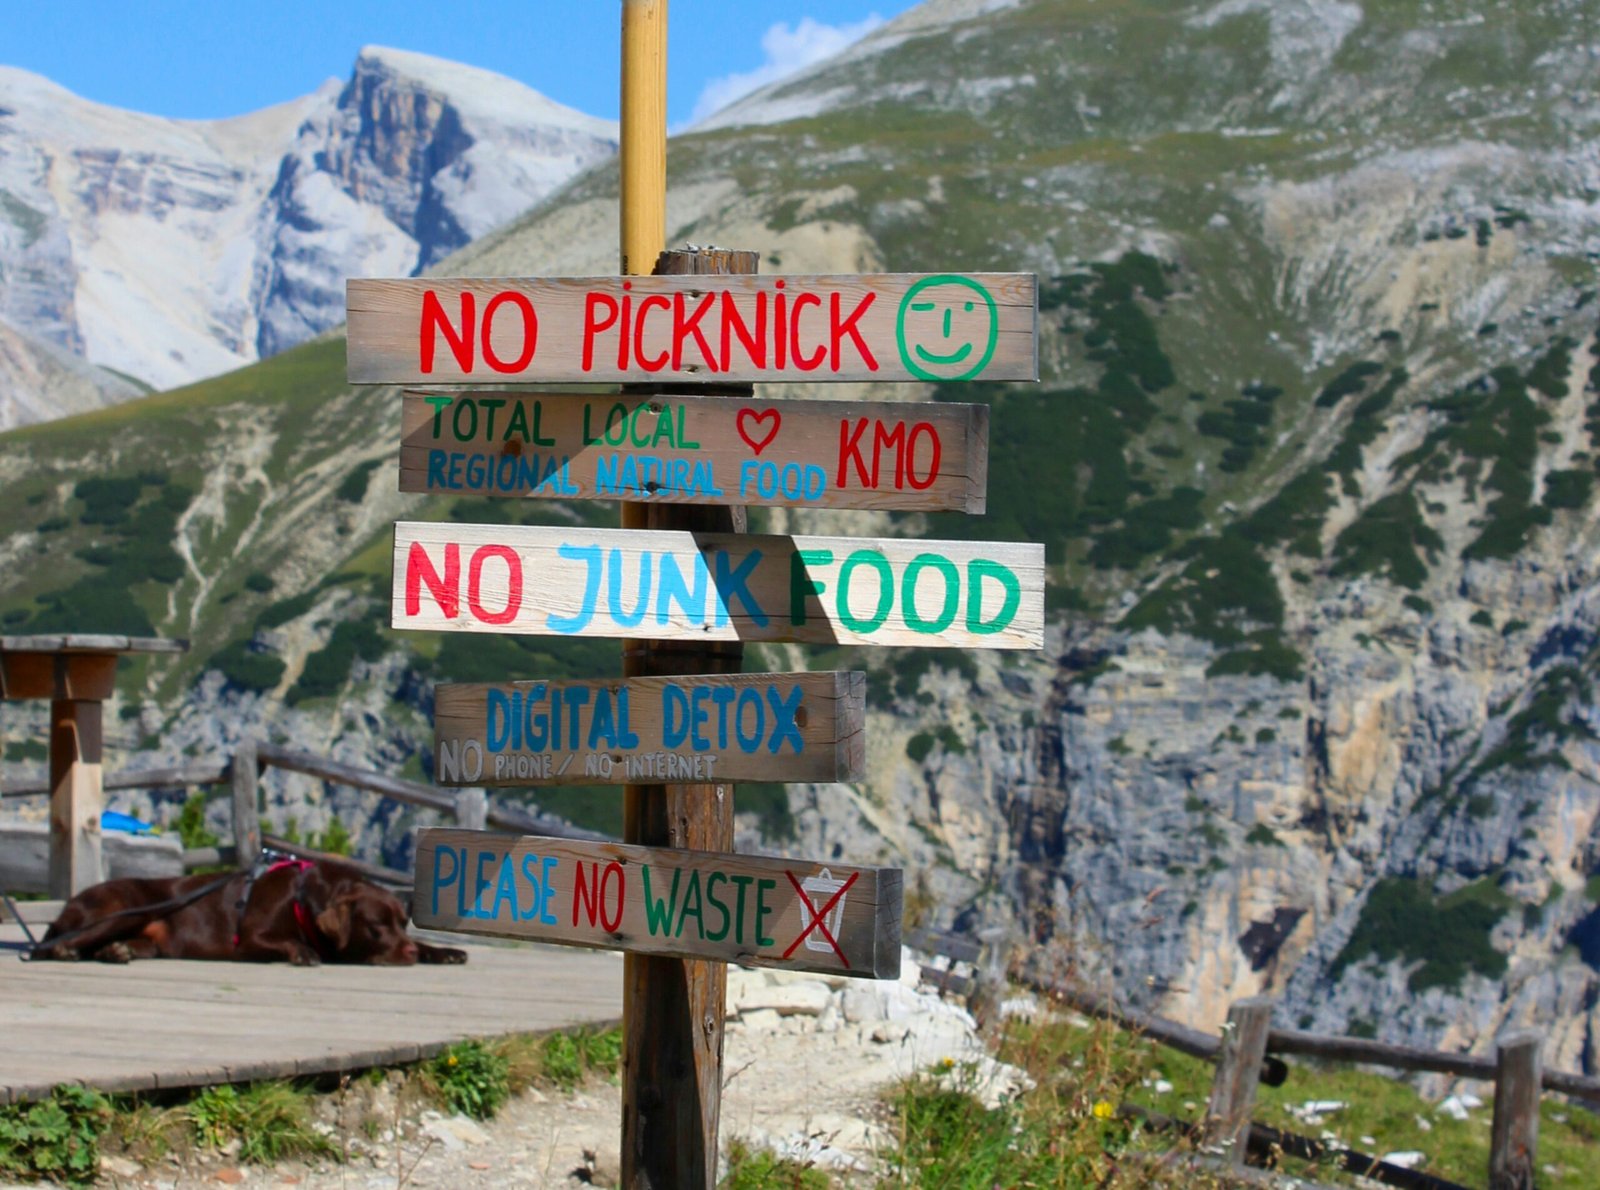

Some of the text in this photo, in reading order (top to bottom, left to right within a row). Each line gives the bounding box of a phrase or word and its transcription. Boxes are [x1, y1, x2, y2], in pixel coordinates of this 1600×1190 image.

[420, 289, 537, 373] NO
[425, 396, 555, 446] TOTAL
[583, 402, 700, 449] LOCAL
[427, 448, 827, 501] REGIONAL NATURAL FOOD
[405, 541, 1021, 635] NO JUNK FOOD
[662, 683, 804, 755] DETOX
[440, 739, 483, 782] NO
[585, 751, 613, 779] NO
[625, 752, 719, 782] INTERNET
[431, 845, 777, 946] PLEASE NO WASTE
